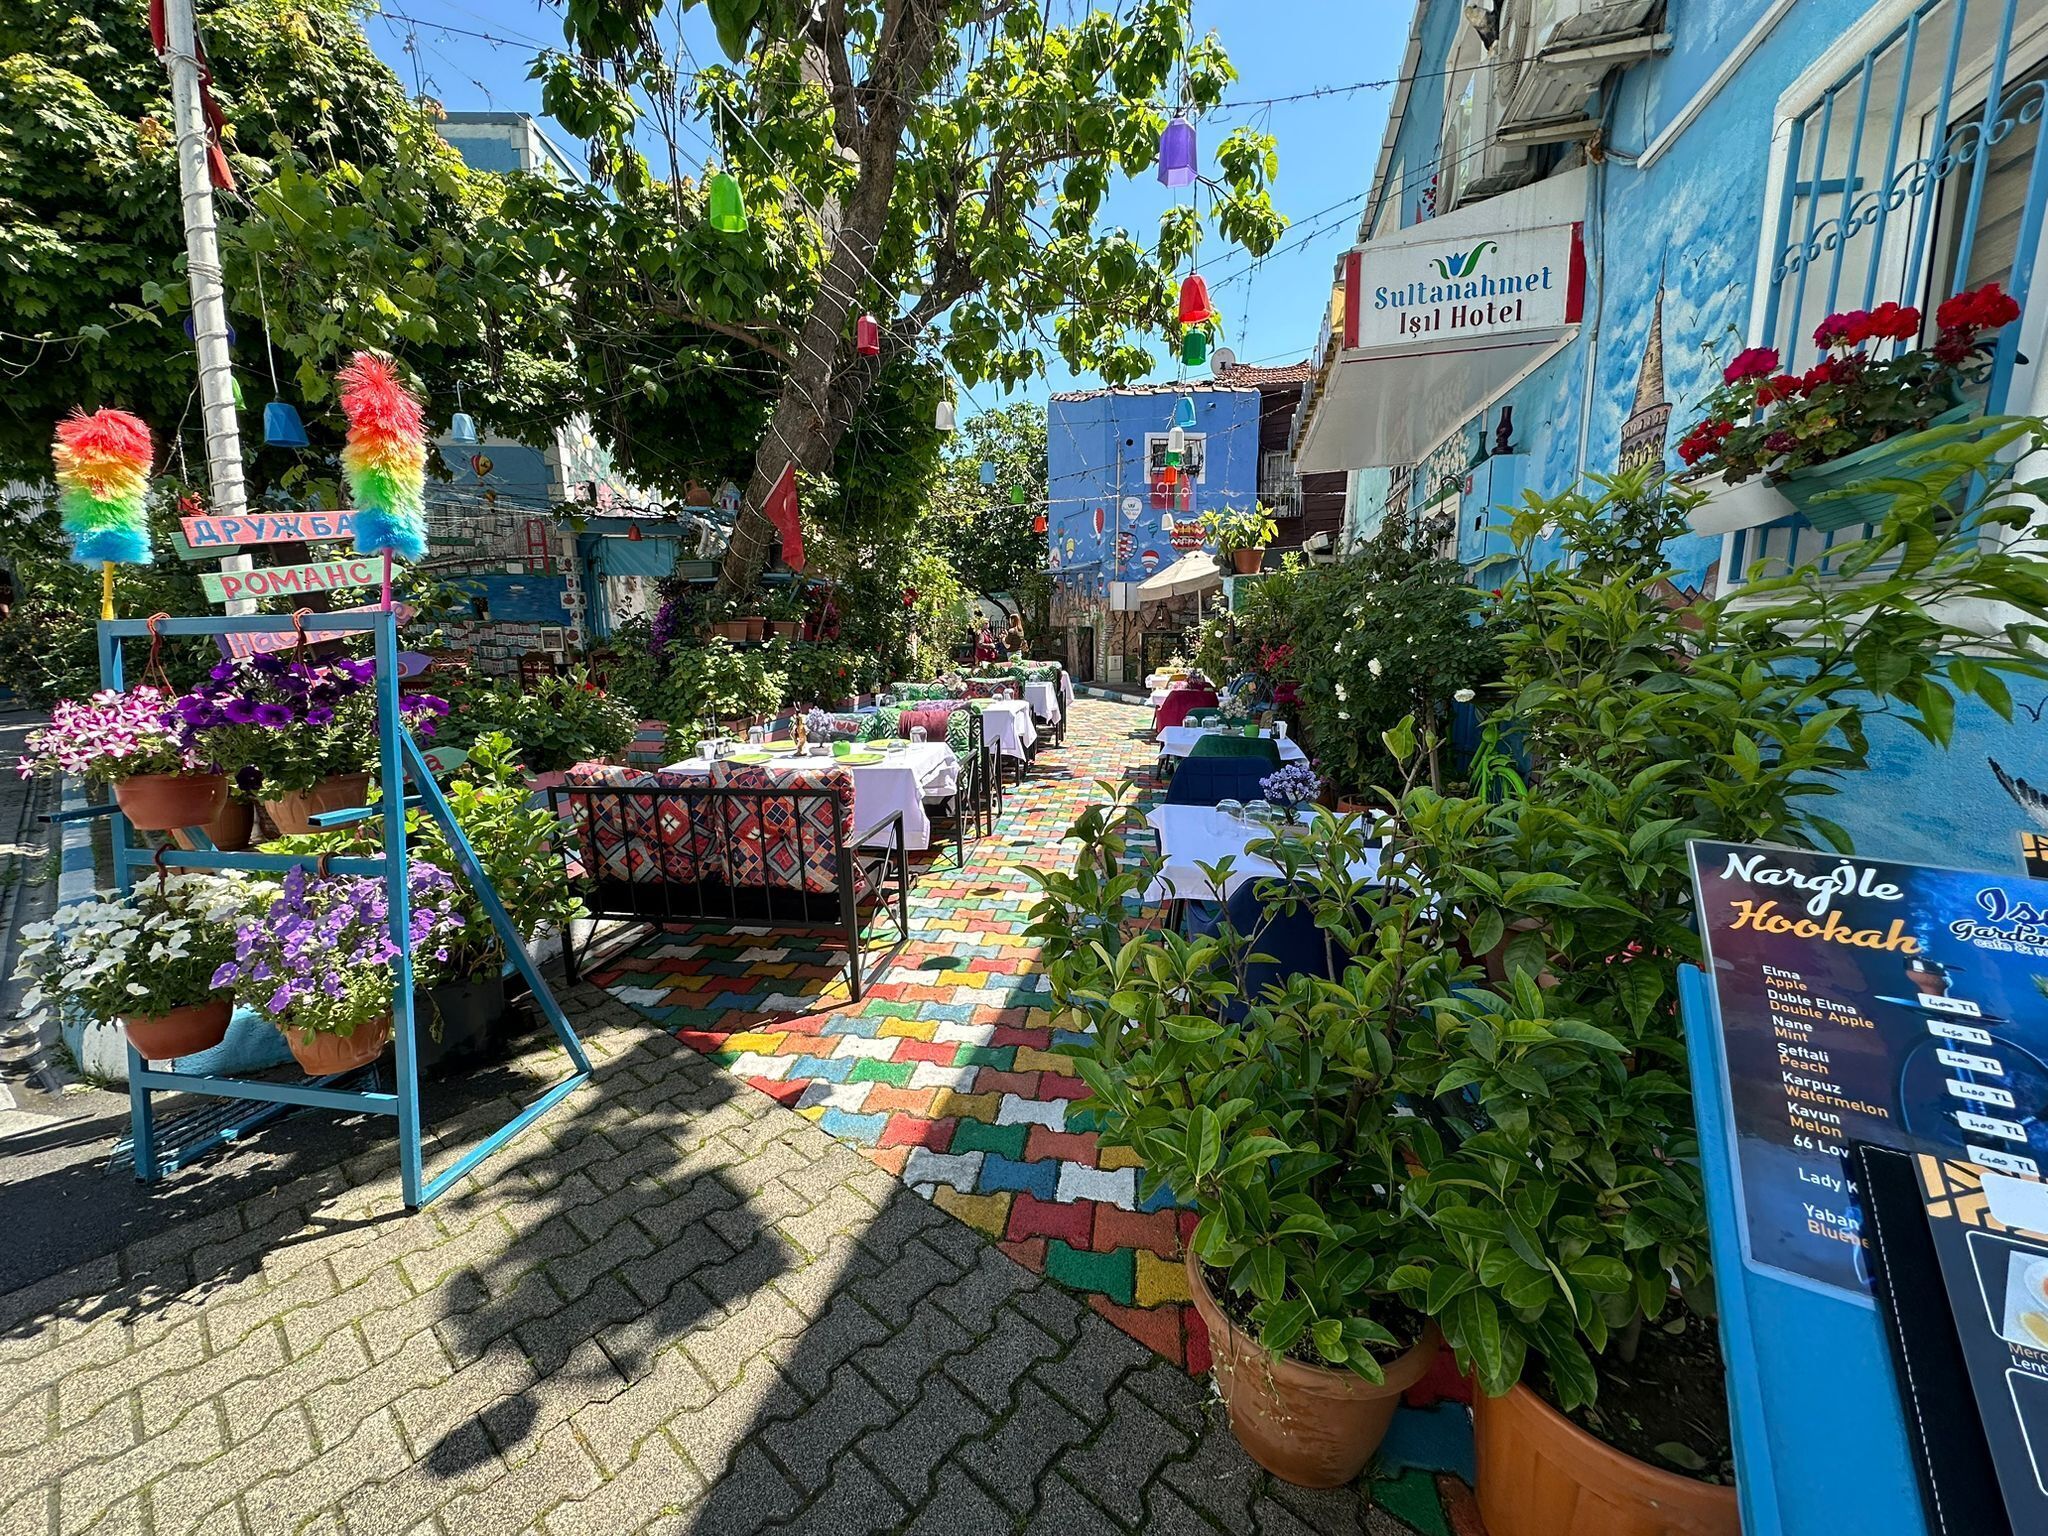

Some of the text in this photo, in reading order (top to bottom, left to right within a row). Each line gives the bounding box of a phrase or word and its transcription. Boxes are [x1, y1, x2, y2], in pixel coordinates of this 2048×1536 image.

[1374, 266, 1552, 310] Sultanahmet
[1400, 299, 1522, 338] Işıl Hotel
[194, 515, 355, 546] ДРУЖБА
[220, 562, 372, 599] РОМАНС
[1729, 900, 1922, 954] Hookah
[1762, 965, 1801, 980] Elma
[1765, 976, 1808, 991] Apple
[1767, 989, 1857, 1015] Duble Elma
[1959, 1003, 1978, 1013] TL
[1769, 1000, 1875, 1029] Double Apple
[1772, 1015, 1813, 1032] Nane
[1774, 1027, 1809, 1043] Mint
[1969, 1031, 1989, 1041] TL
[1780, 1055, 1829, 1074] Peach
[1947, 1054, 2000, 1071] 400 TL
[1782, 1071, 1842, 1094] Karpuz
[1960, 1085, 2012, 1103] 400 TL
[1784, 1084, 1889, 1118] Watermelon
[1787, 1101, 1841, 1124] Kavun
[1790, 1115, 1843, 1138] Melon
[1969, 1119, 2024, 1136] 400 TL
[1793, 1134, 1813, 1149] 66
[2015, 1160, 2037, 1172] TL
[1798, 1167, 1841, 1192] Lady
[1802, 1202, 1860, 1231] Yaban
